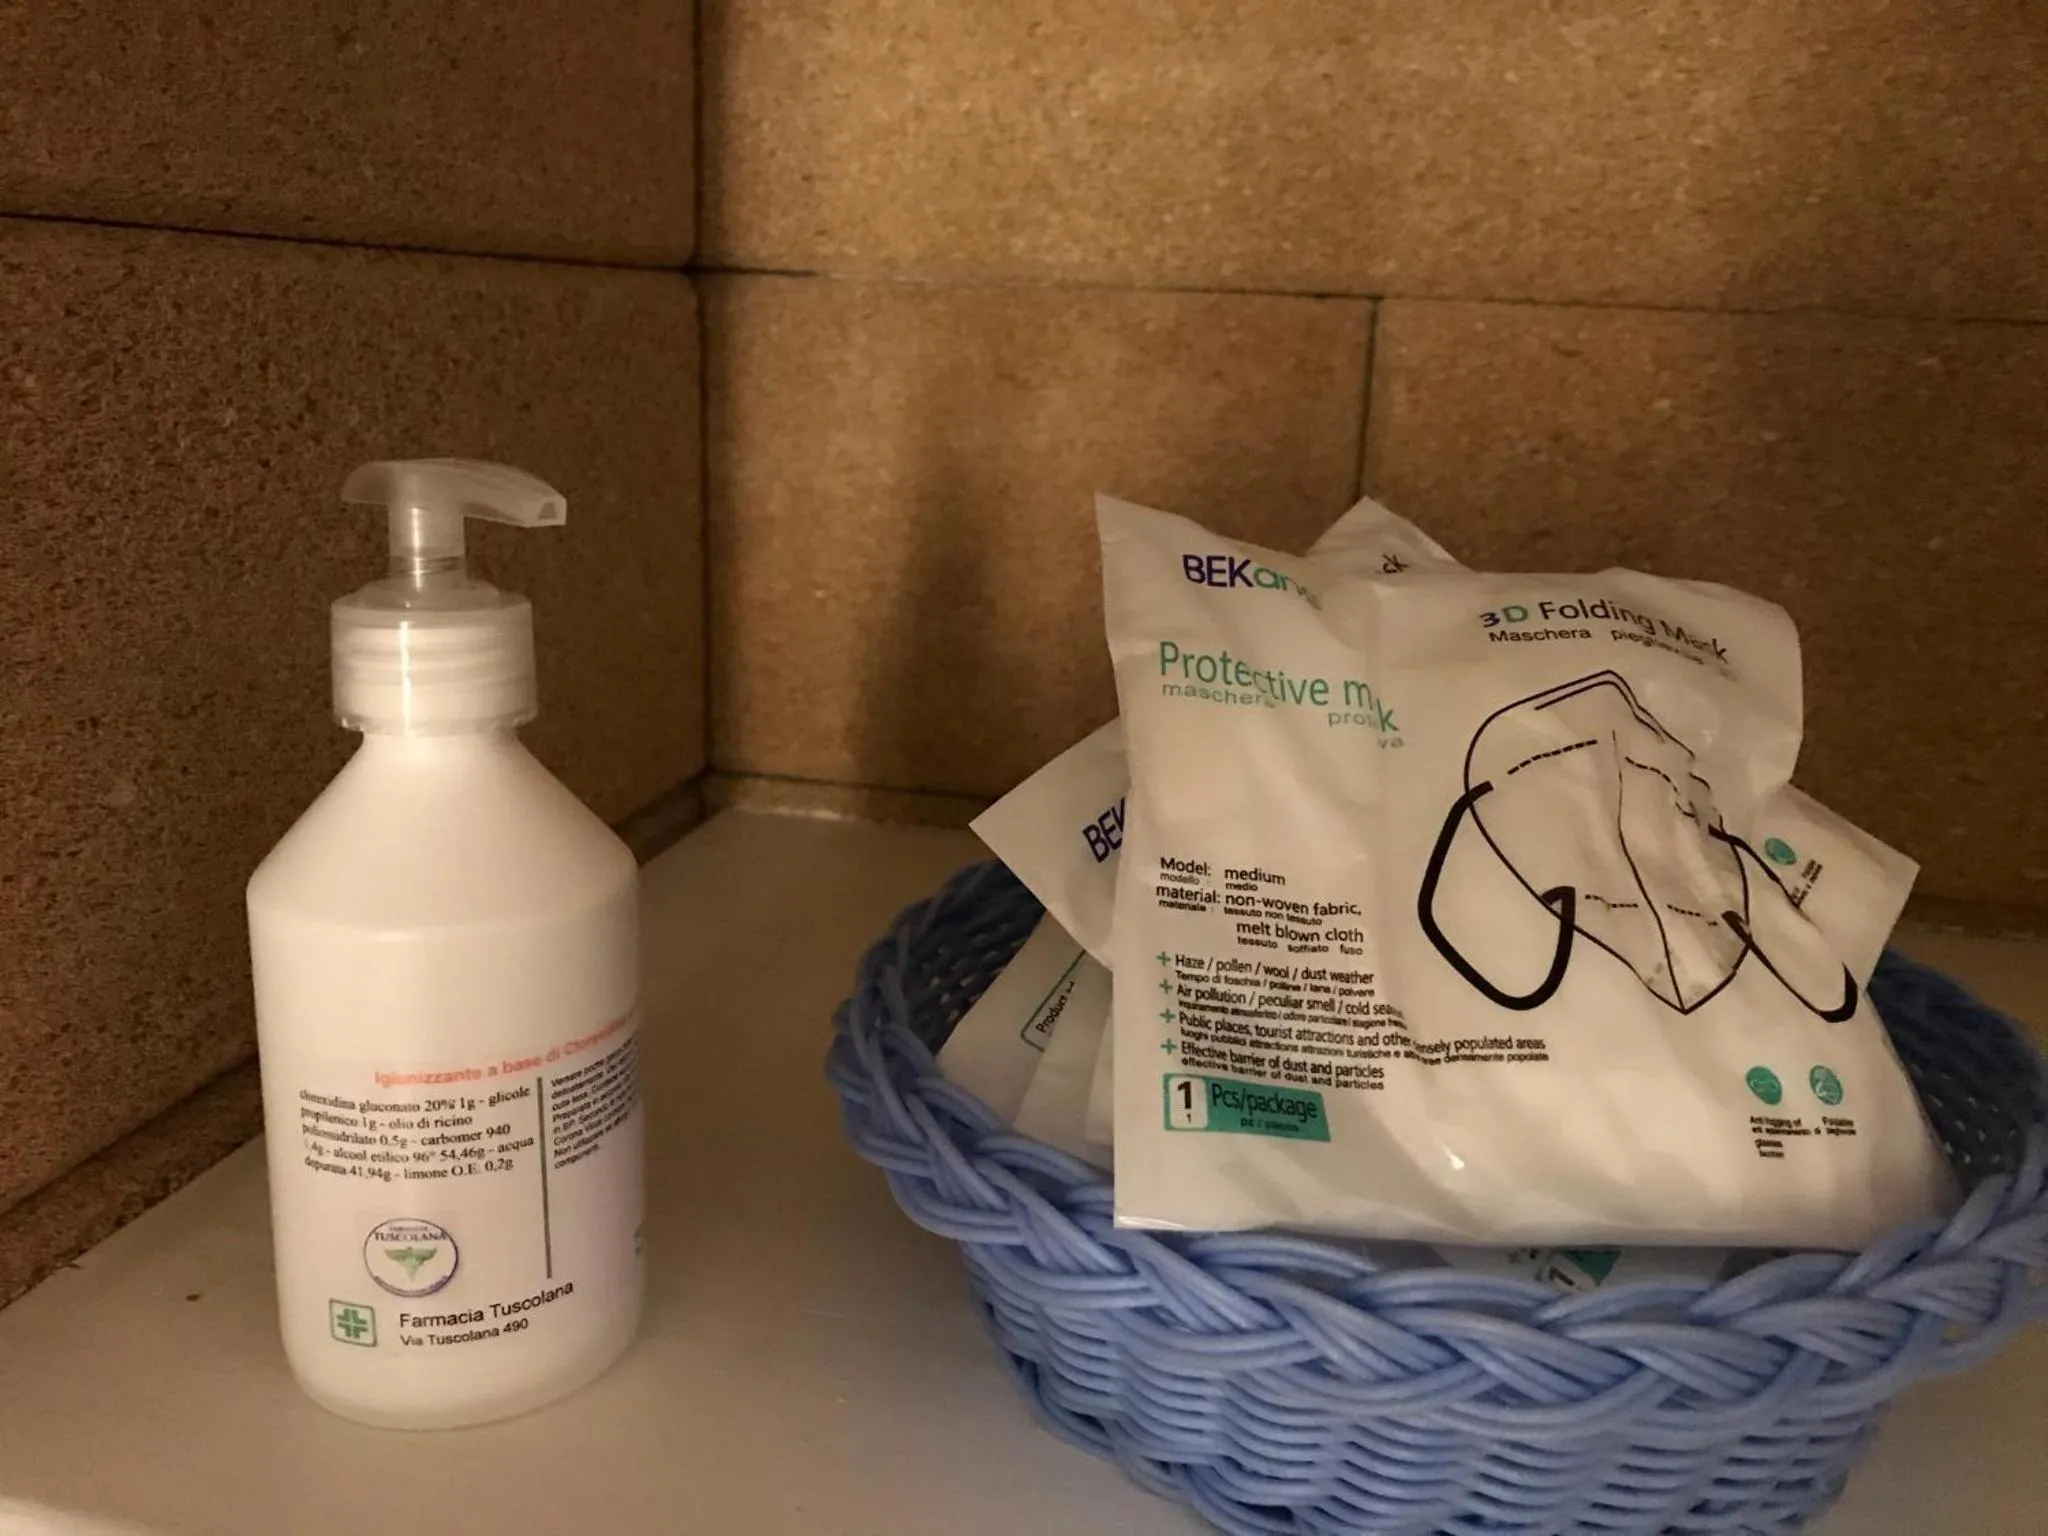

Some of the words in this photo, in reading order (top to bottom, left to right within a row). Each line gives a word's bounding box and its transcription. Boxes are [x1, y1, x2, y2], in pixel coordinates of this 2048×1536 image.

[1480, 604, 1528, 628] 3D
[1538, 599, 1655, 635] Folding
[1490, 628, 1592, 642] Maschera
[1159, 641, 1329, 706] Protective
[1160, 857, 1211, 876] Model:
[1224, 867, 1286, 885] medium
[1156, 885, 1221, 904] material:
[1225, 893, 1309, 915] non-woven
[1313, 902, 1362, 917] fabric,
[1225, 882, 1258, 892] medio
[1237, 922, 1271, 936] melt
[1276, 926, 1320, 942] blown
[1325, 928, 1364, 943] cloth
[1175, 954, 1205, 970] Haze
[1216, 957, 1252, 976] pollen
[1263, 965, 1290, 979] wool
[1301, 967, 1327, 981] dust
[1329, 970, 1375, 985] weather
[1177, 983, 1192, 997] Air
[1195, 986, 1247, 1004] pollution
[1258, 993, 1303, 1009] peculiar
[1307, 998, 1335, 1012] smell
[1345, 1001, 1370, 1015] cold
[1179, 1011, 1212, 1030] Public
[1255, 1024, 1292, 1039] tourist
[1295, 1028, 1354, 1045] attractions
[1357, 1032, 1379, 1046] and
[1454, 1034, 1513, 1053] populated
[1516, 1037, 1546, 1050] areas
[375, 1066, 482, 1089] Igienizzante
[488, 1065, 499, 1078] a
[503, 1055, 543, 1073] base
[546, 1047, 561, 1063] di
[1181, 1041, 1227, 1061] Effective
[1230, 1050, 1265, 1066] barrier
[1268, 1054, 1280, 1068] of
[1283, 1057, 1308, 1072] dust
[1311, 1060, 1332, 1075] and
[1335, 1062, 1384, 1080] particles
[359, 1099, 421, 1113] gluconato
[425, 1098, 456, 1112] 20%
[488, 1086, 531, 1107] glicole
[1177, 1081, 1192, 1110] 1
[388, 1118, 414, 1130] olio
[417, 1117, 430, 1130] di
[434, 1115, 473, 1129] ricino
[421, 1131, 482, 1147] carbomer
[486, 1123, 511, 1139] 940
[497, 1136, 535, 1154] acqua
[404, 1167, 448, 1180] limone
[400, 1308, 484, 1329] Farmacia
[490, 1280, 574, 1319] Tuscolana
[400, 1334, 424, 1347] Via
[428, 1325, 499, 1347] Tuscolana
[503, 1318, 528, 1333] 490
